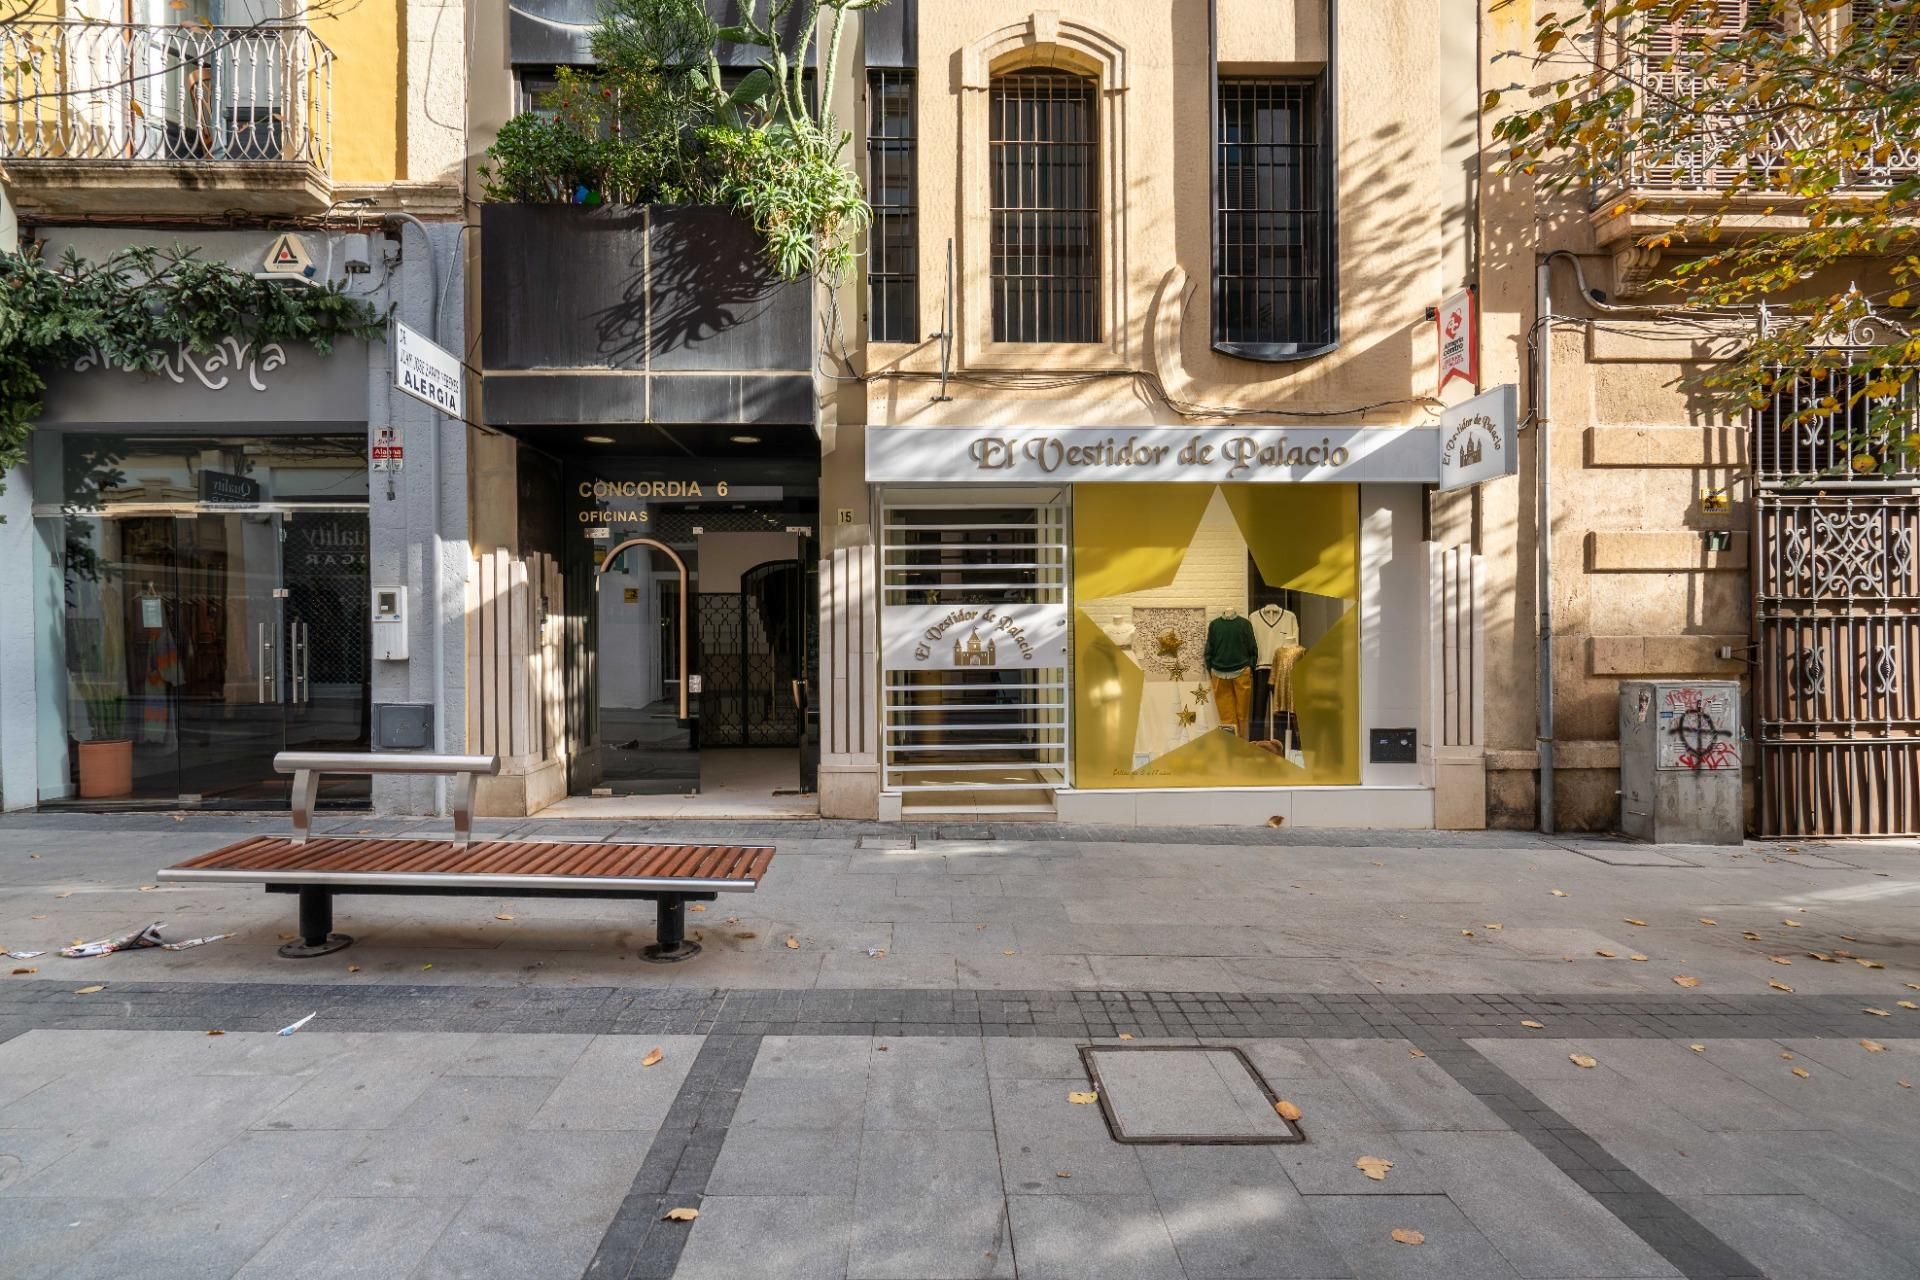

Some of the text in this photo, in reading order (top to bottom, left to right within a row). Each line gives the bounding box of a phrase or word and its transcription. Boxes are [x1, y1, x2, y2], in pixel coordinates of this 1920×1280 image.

[404, 369, 456, 411] ALERGIA
[968, 435, 1350, 478] El Vestidor de Palacio
[578, 480, 729, 498] CONCORDIA 6
[578, 511, 649, 523] OFICINAS
[840, 511, 852, 523] 15
[914, 608, 1034, 662] El Vestidor de Palacio
